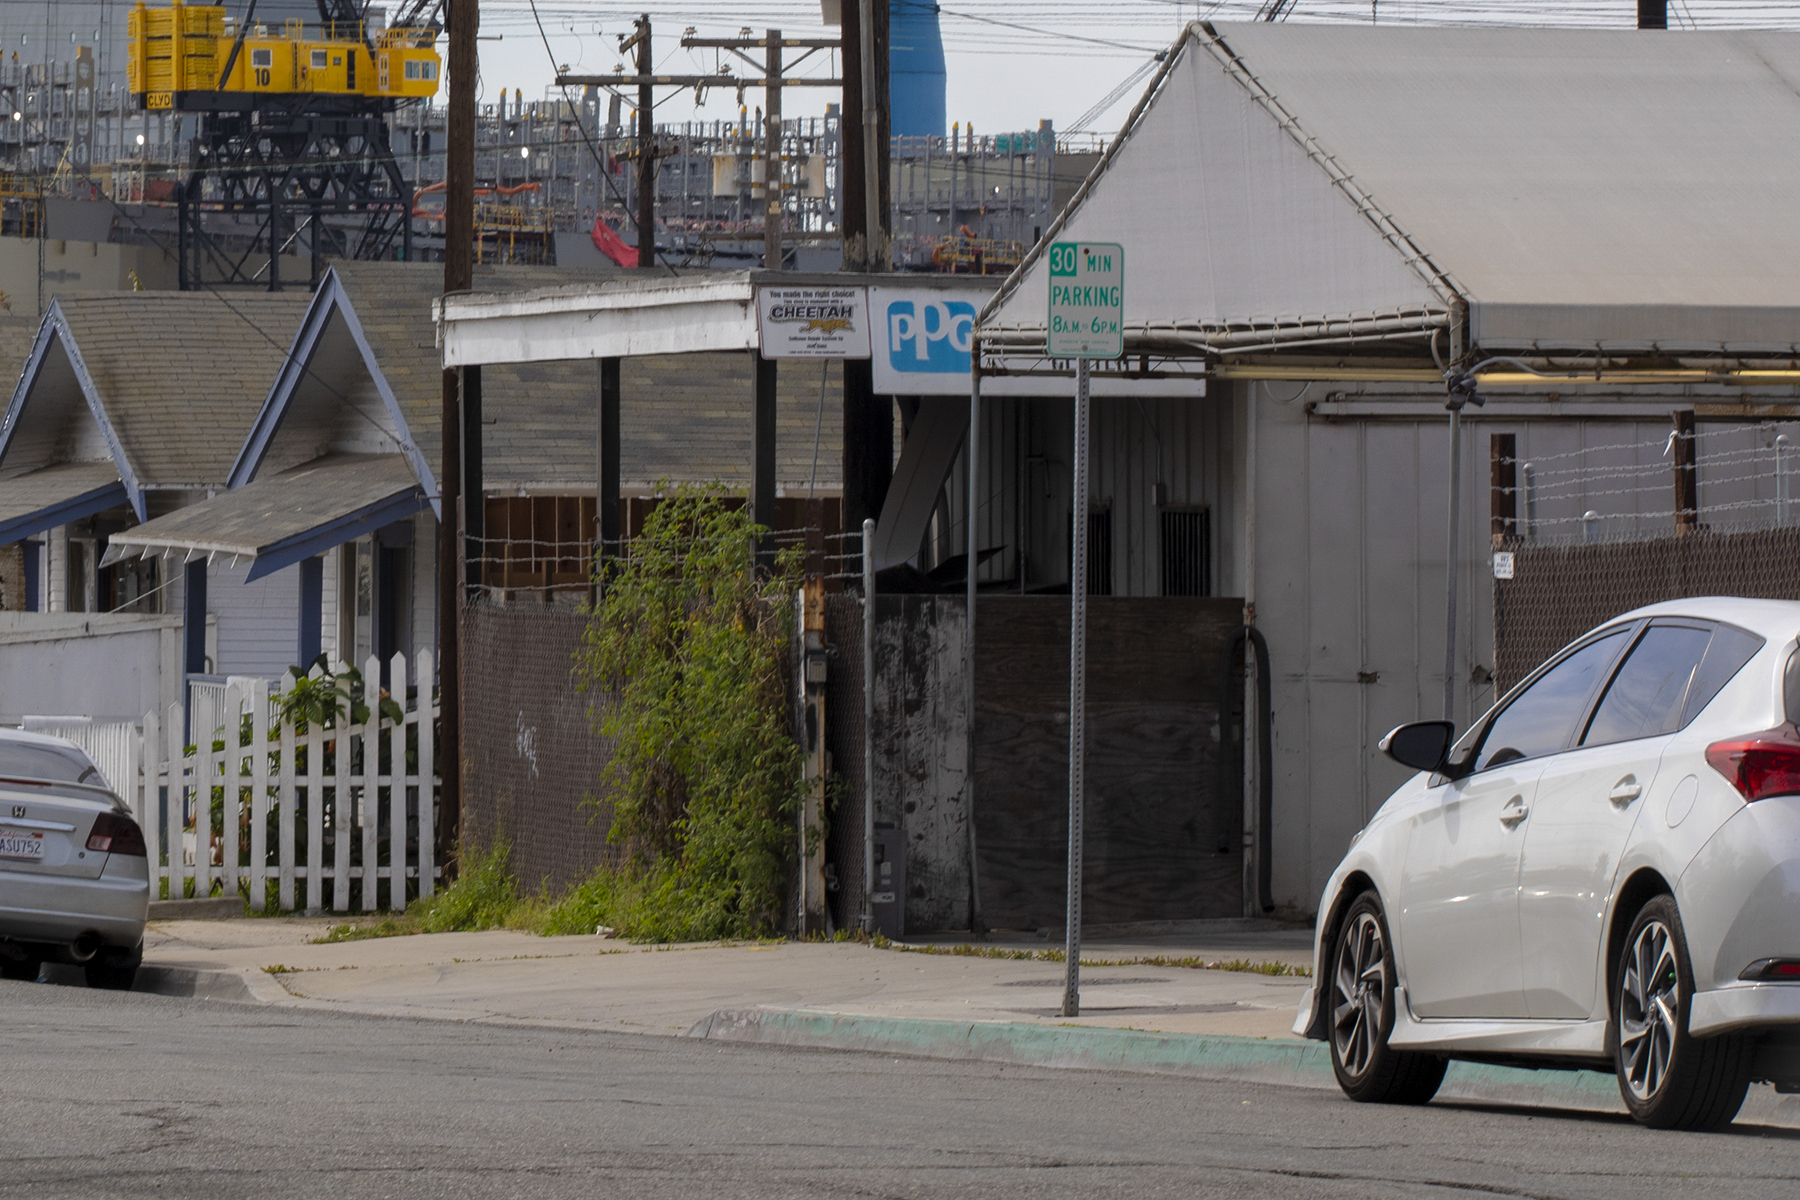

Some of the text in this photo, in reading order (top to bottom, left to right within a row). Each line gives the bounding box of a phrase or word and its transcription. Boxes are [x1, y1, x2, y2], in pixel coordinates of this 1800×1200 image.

[255, 68, 270, 87] 10
[148, 94, 173, 107] CLYD
[1051, 247, 1111, 273] 30 MIN
[1052, 285, 1119, 307] PARKING
[771, 306, 853, 318] CHEETAH
